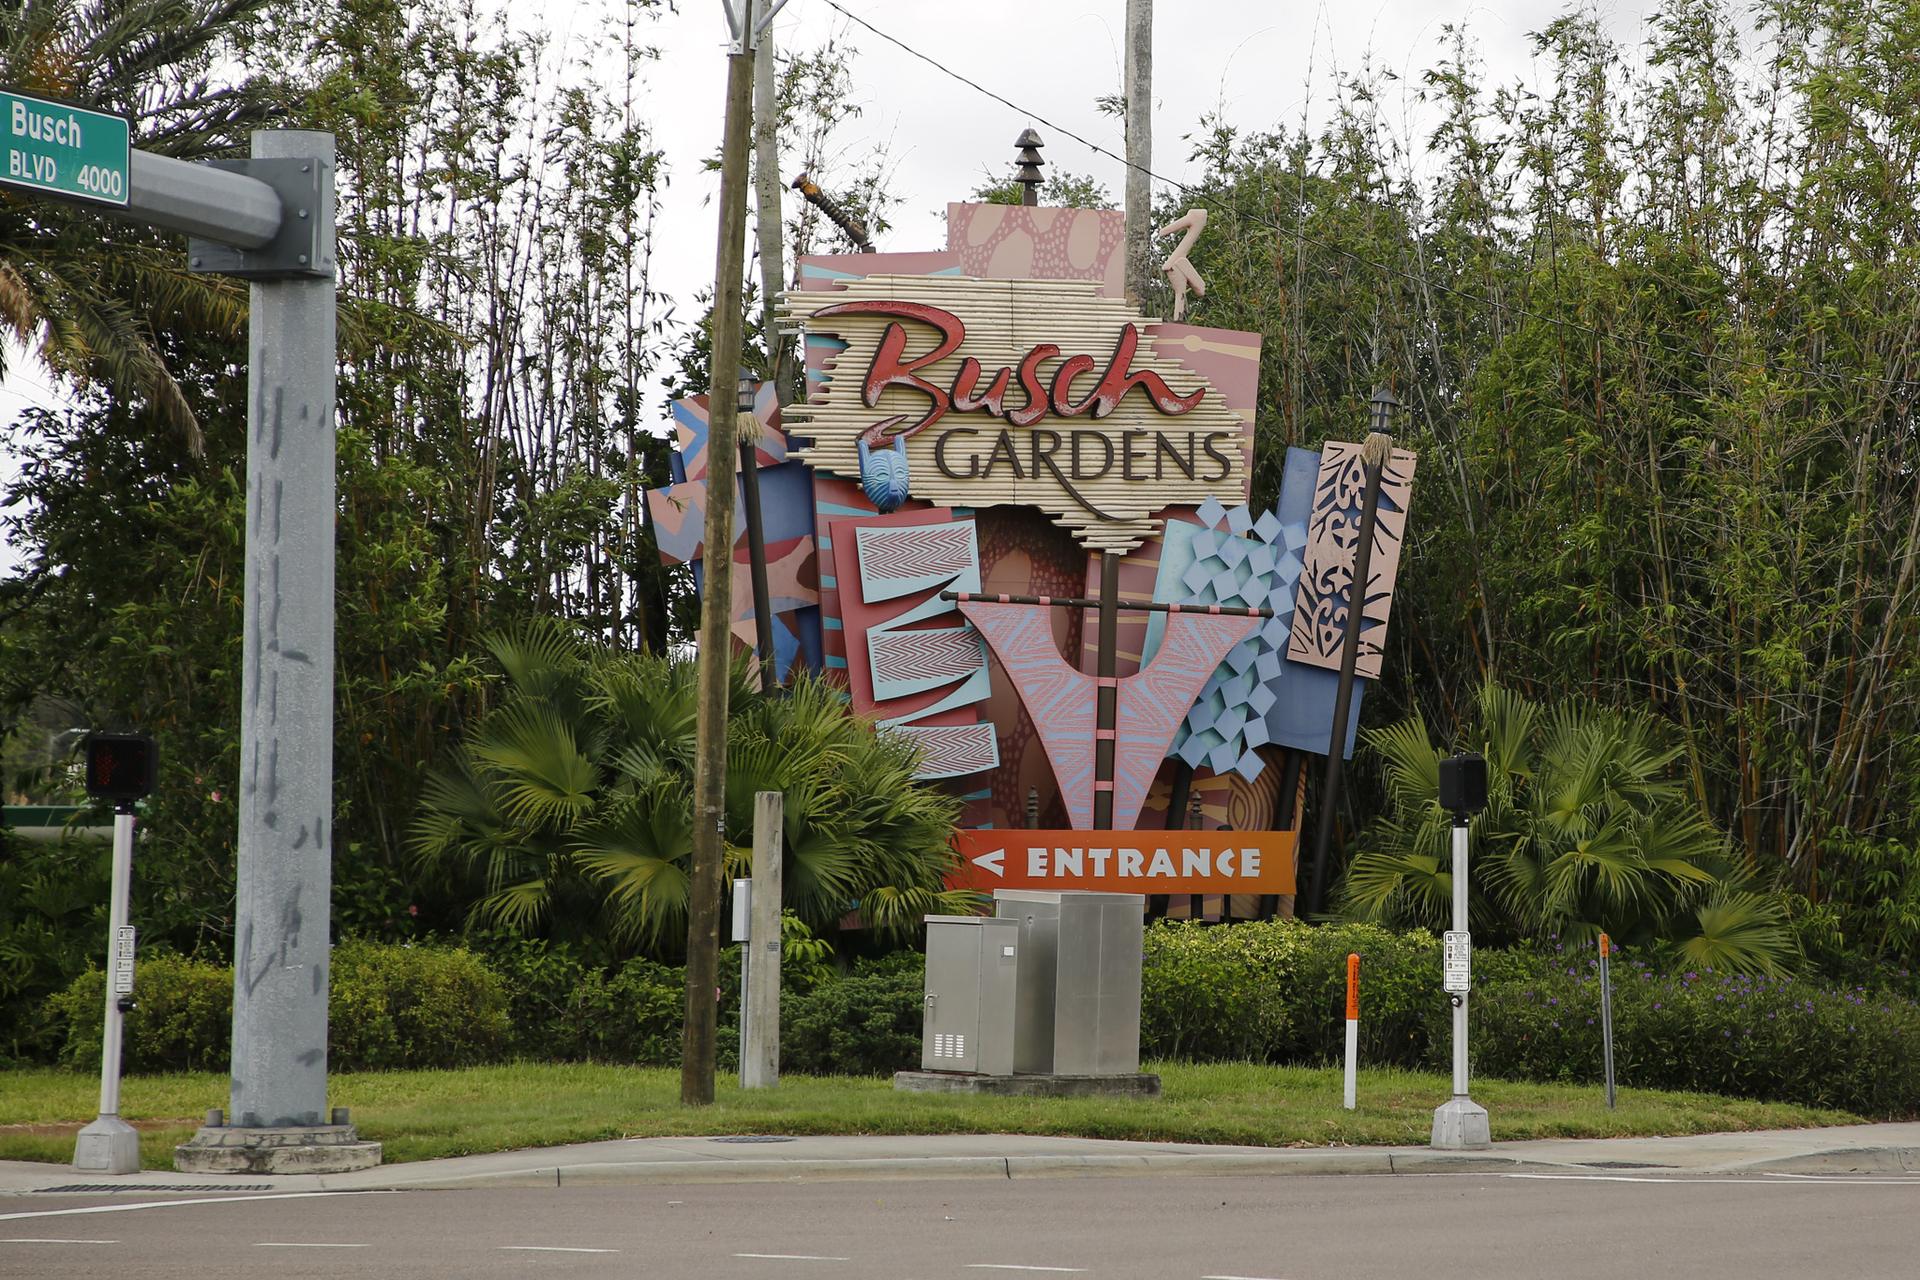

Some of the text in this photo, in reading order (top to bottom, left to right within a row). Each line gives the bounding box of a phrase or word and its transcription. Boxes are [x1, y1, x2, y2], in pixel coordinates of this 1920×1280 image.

[11, 101, 81, 149] Busch
[9, 149, 122, 197] BLVD 4000
[809, 300, 1206, 447] Busch
[935, 428, 1231, 521] GARDENS
[1027, 847, 1262, 878] ENTRANCE
